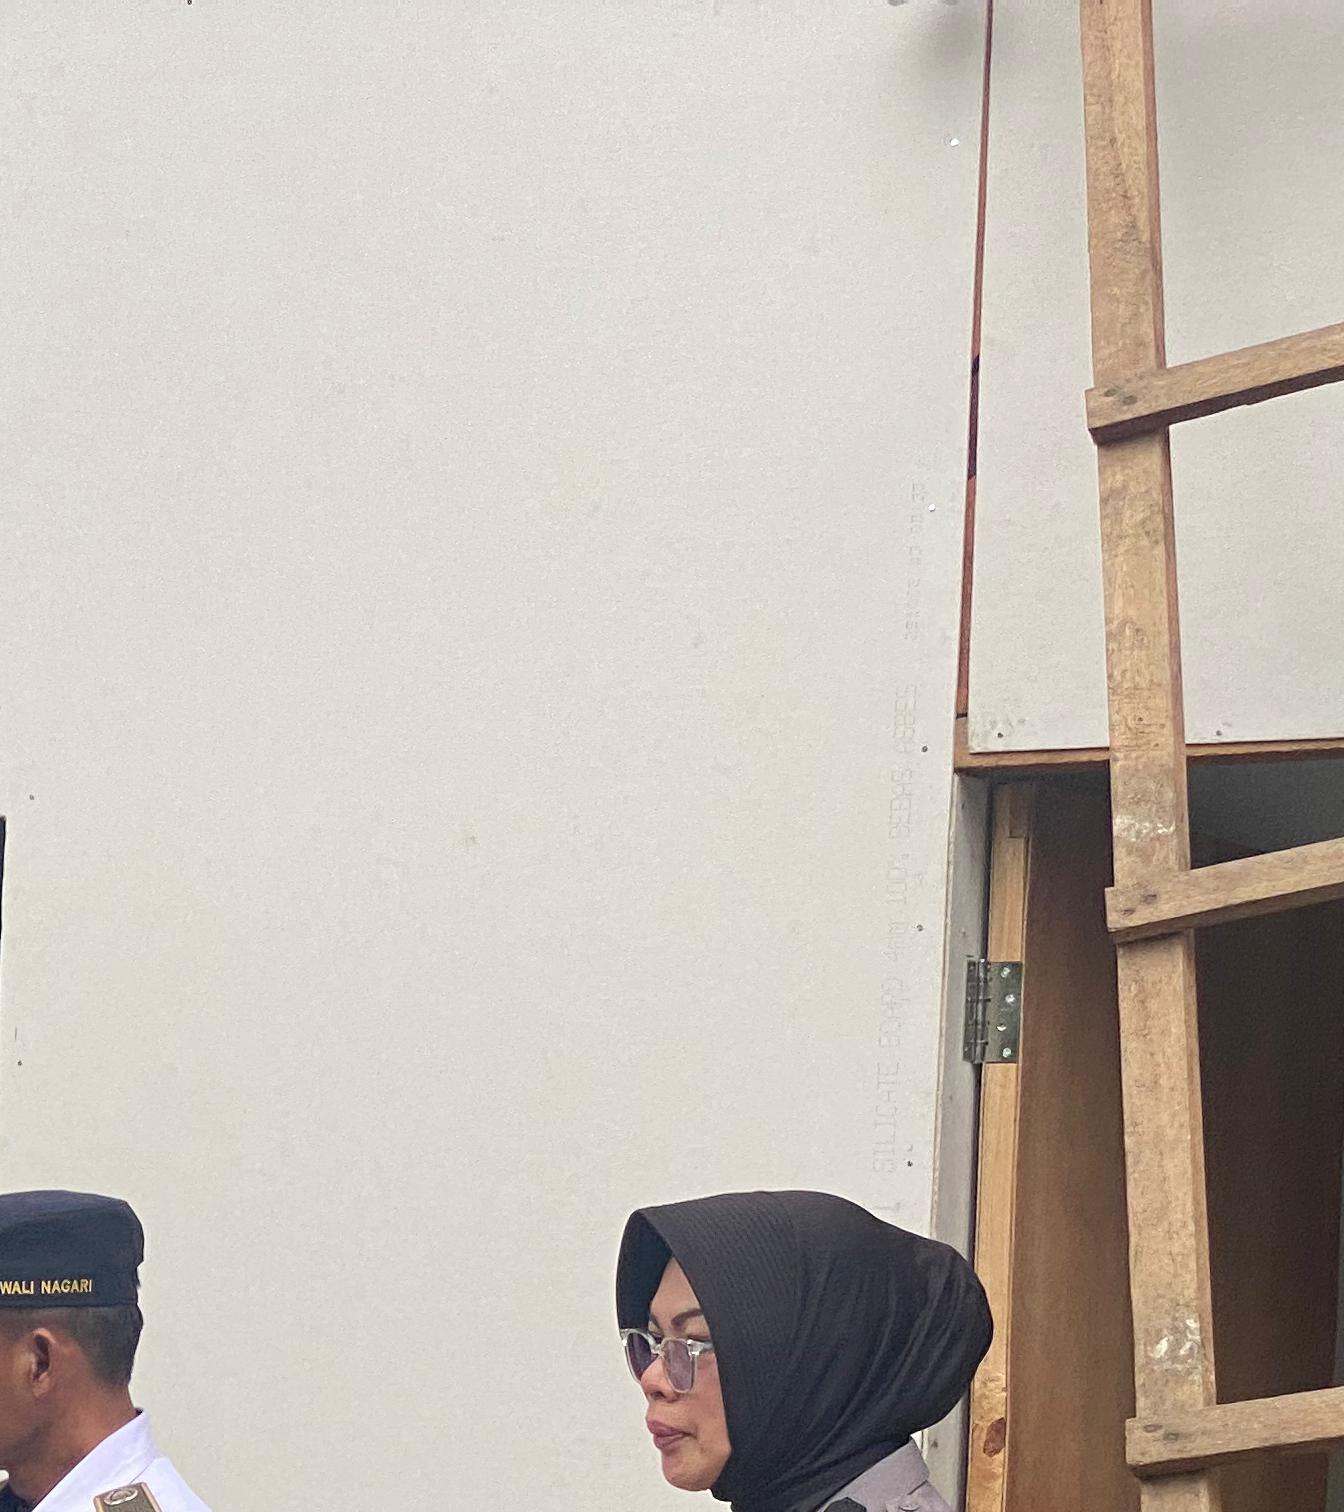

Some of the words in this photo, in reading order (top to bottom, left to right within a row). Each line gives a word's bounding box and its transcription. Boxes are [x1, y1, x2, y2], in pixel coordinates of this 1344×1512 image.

[878, 976, 904, 1049] BOARD
[872, 1061, 900, 1173] SILICATE
[0, 1280, 34, 1294] WALI
[41, 1278, 92, 1294] NAGARI
